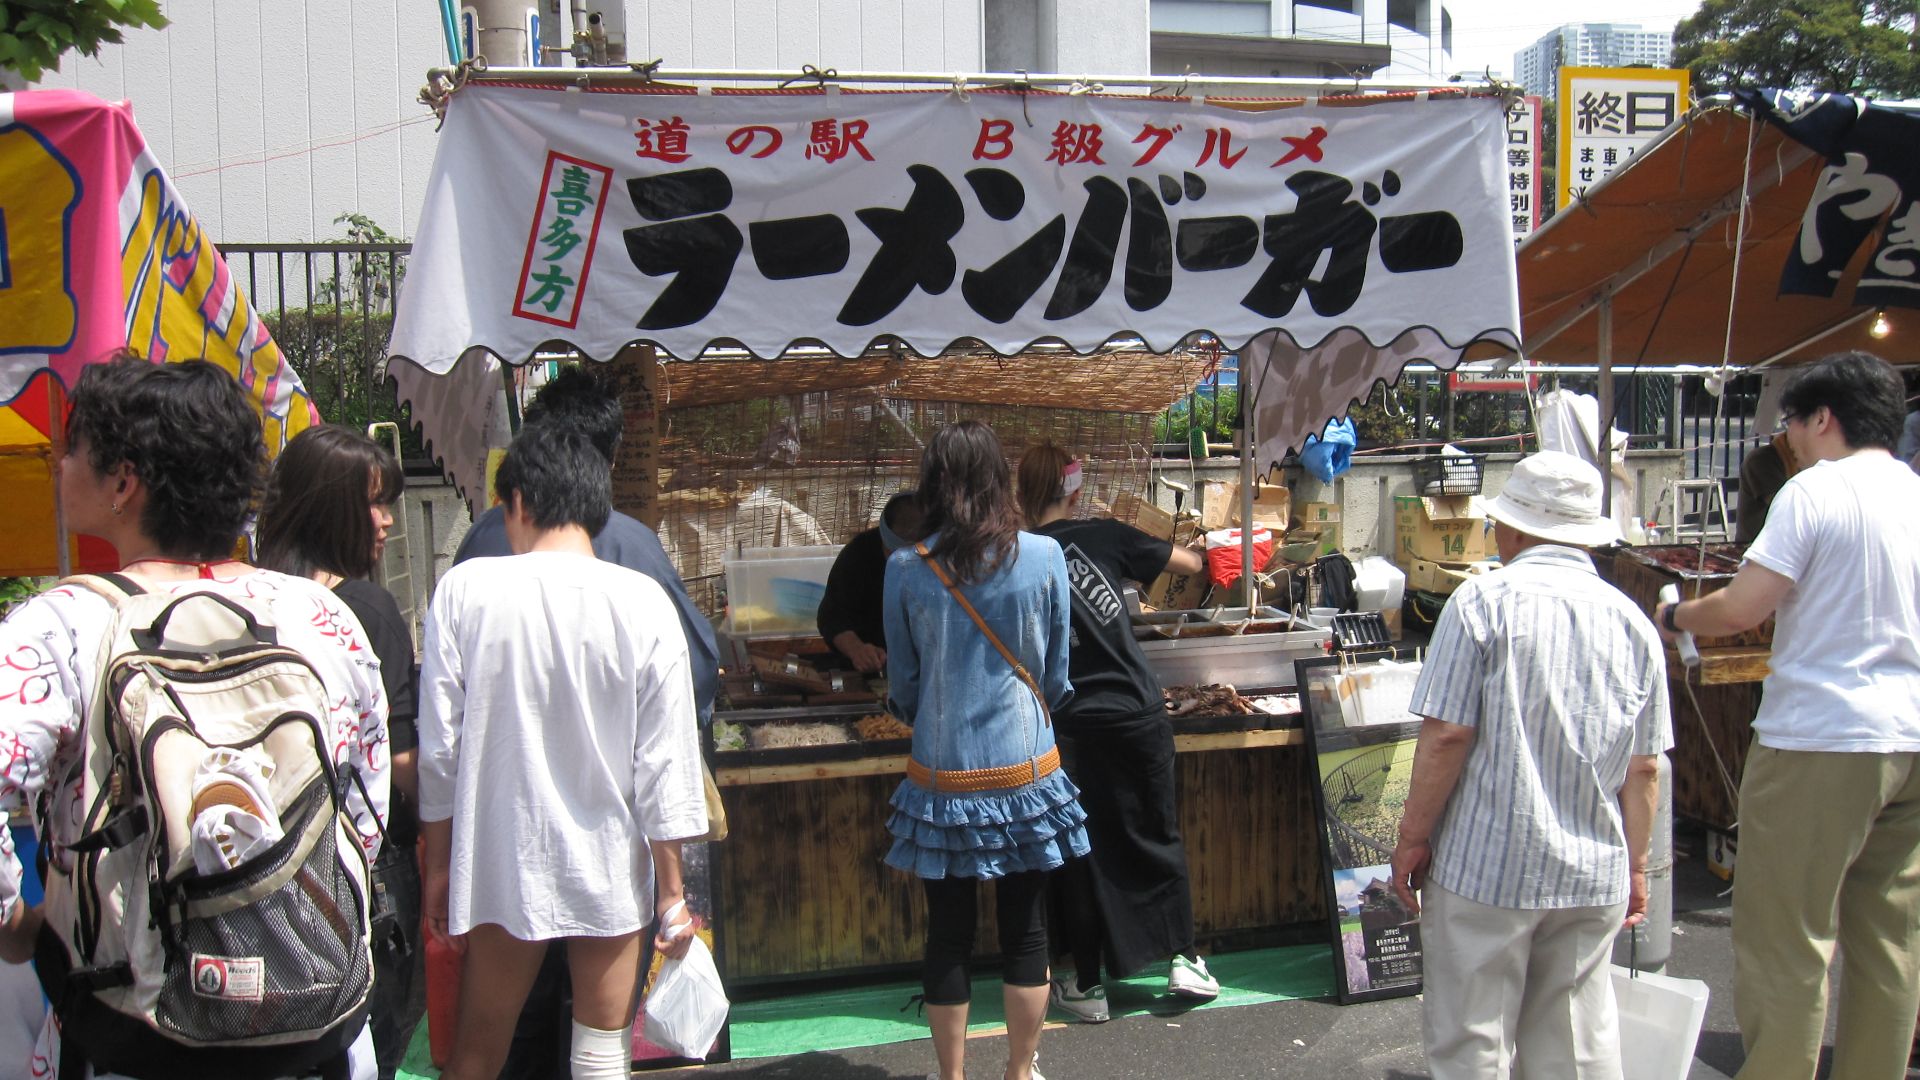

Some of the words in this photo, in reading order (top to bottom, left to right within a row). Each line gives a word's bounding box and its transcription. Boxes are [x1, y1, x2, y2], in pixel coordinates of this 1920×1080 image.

[1577, 91, 1675, 135] 終日
[634, 116, 875, 163] 道の駅
[971, 118, 1328, 170] B級グルメ
[524, 165, 594, 312] 喜多方
[622, 164, 1463, 330] ラーメンバーガー
[1441, 534, 1465, 555] 14
